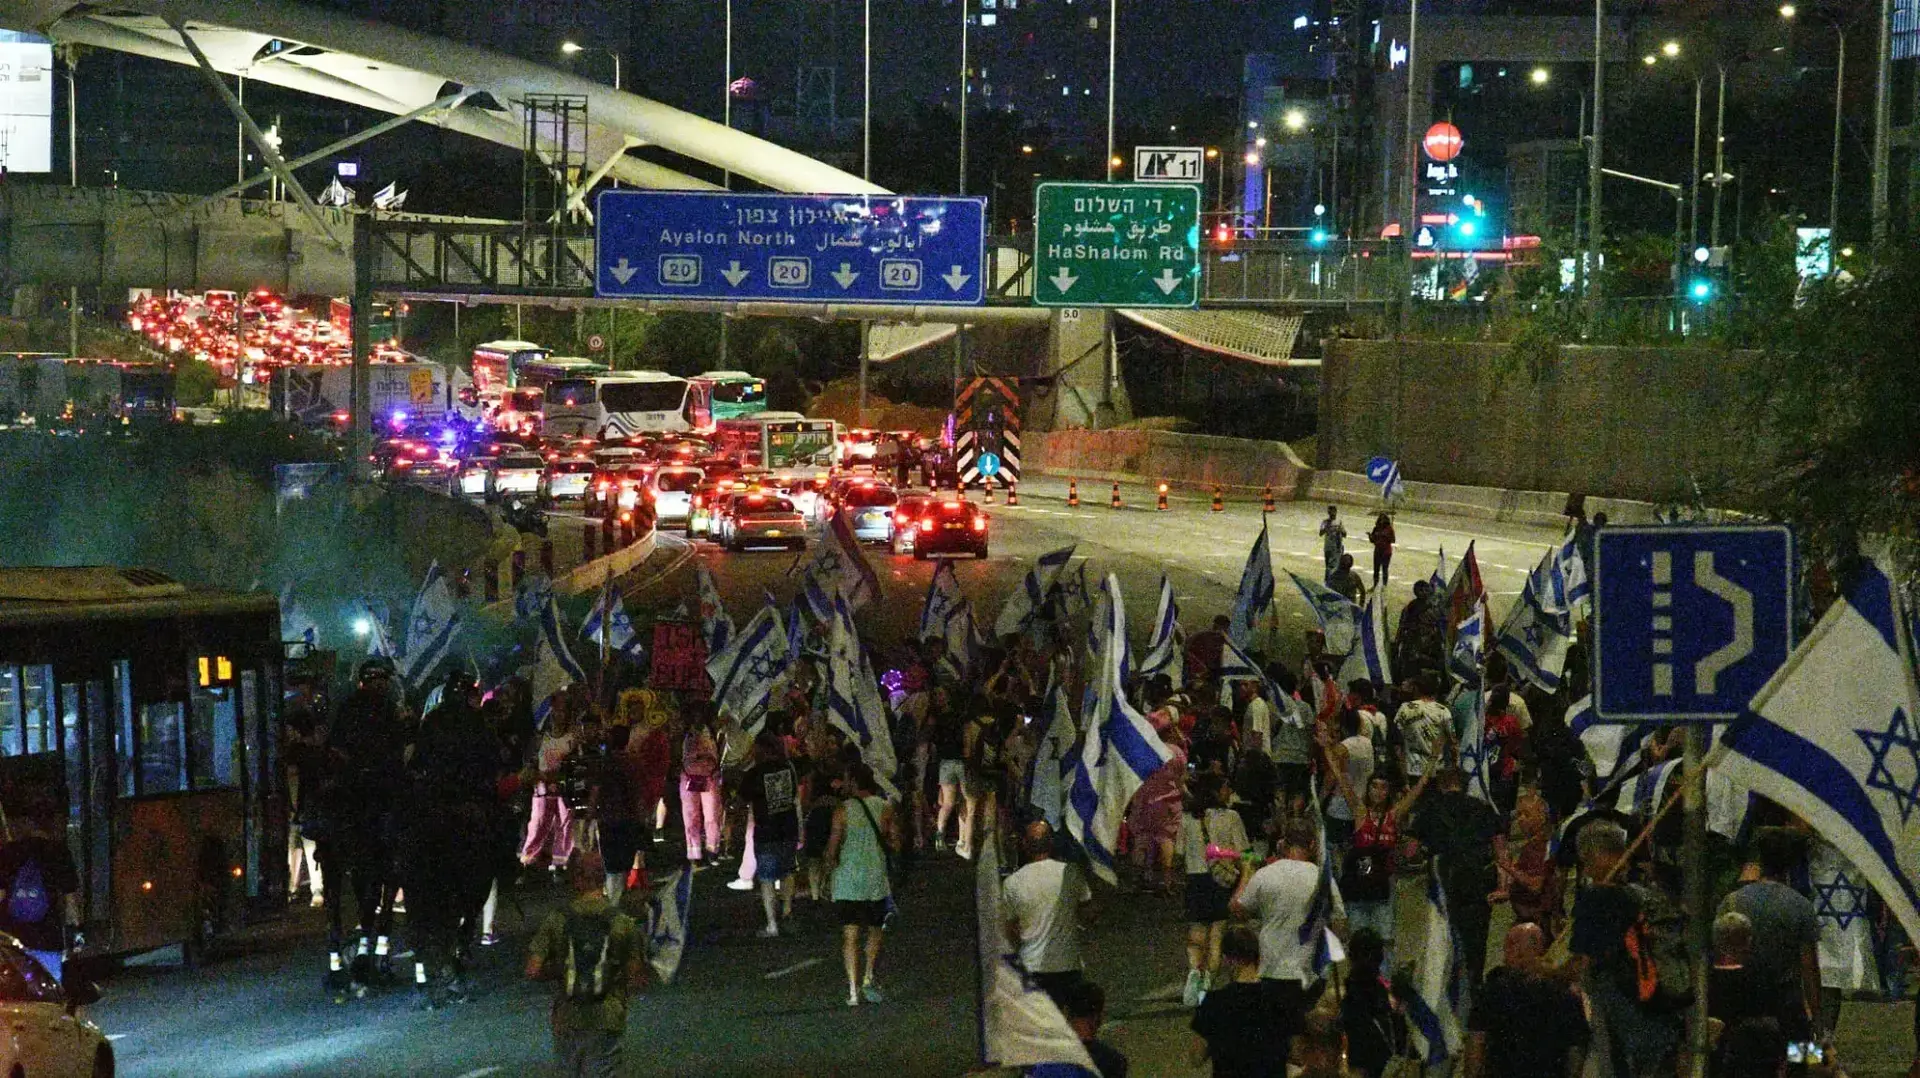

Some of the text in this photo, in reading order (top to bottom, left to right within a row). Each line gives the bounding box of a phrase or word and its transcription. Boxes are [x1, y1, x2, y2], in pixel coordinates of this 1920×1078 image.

[1179, 159, 1197, 177] 11
[1073, 195, 1134, 214] השלום
[736, 207, 779, 226] צפון
[659, 228, 796, 247] Ayalon North
[1126, 219, 1172, 244] طريق
[1048, 244, 1185, 261] HaShalom Rd
[668, 263, 692, 278] 20
[778, 266, 801, 280] 20
[890, 267, 912, 282] 20
